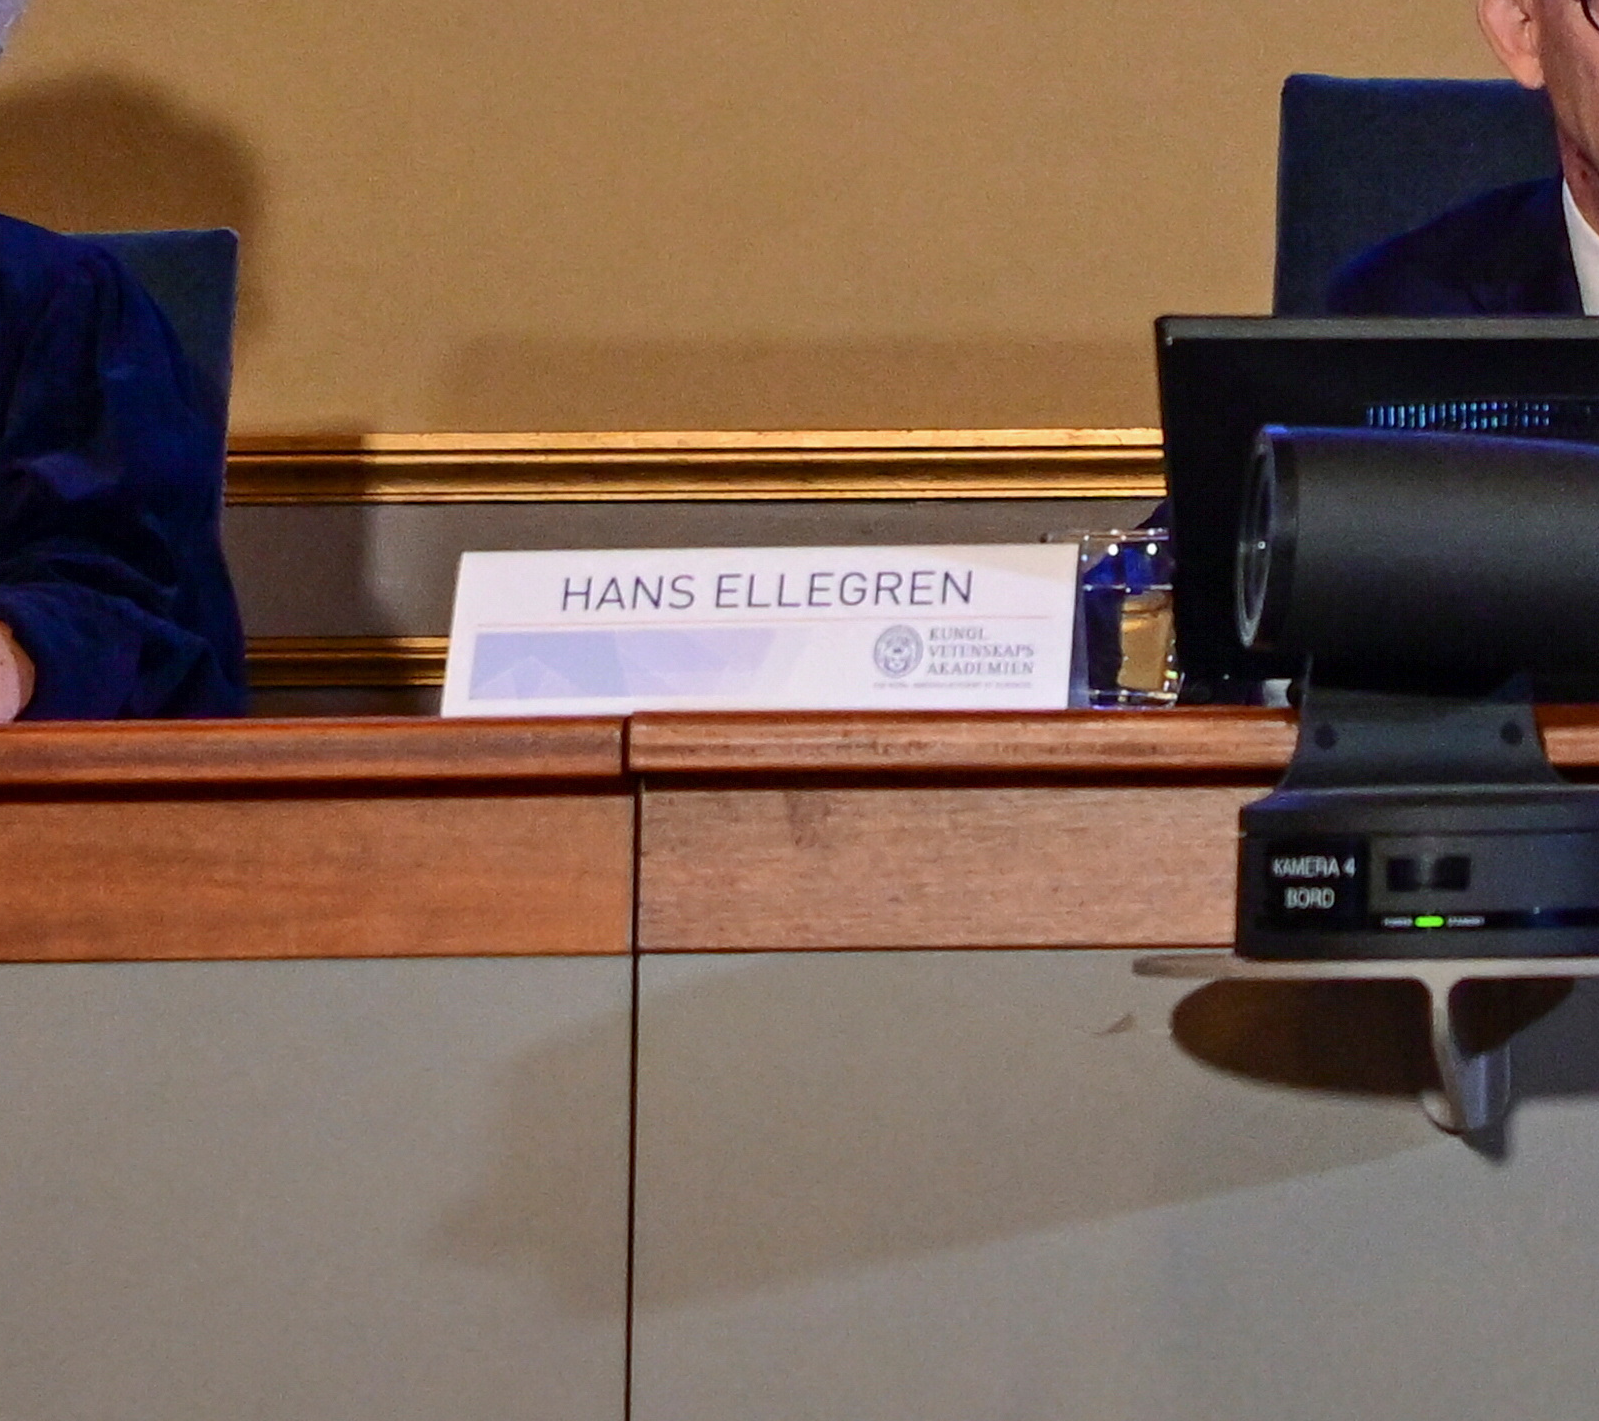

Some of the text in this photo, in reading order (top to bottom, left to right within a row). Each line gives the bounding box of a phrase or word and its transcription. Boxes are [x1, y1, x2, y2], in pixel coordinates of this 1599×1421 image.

[562, 571, 972, 610] HANS ELLEGREN
[1273, 856, 1355, 877] KAMERA 4
[1286, 887, 1334, 908] BORD
